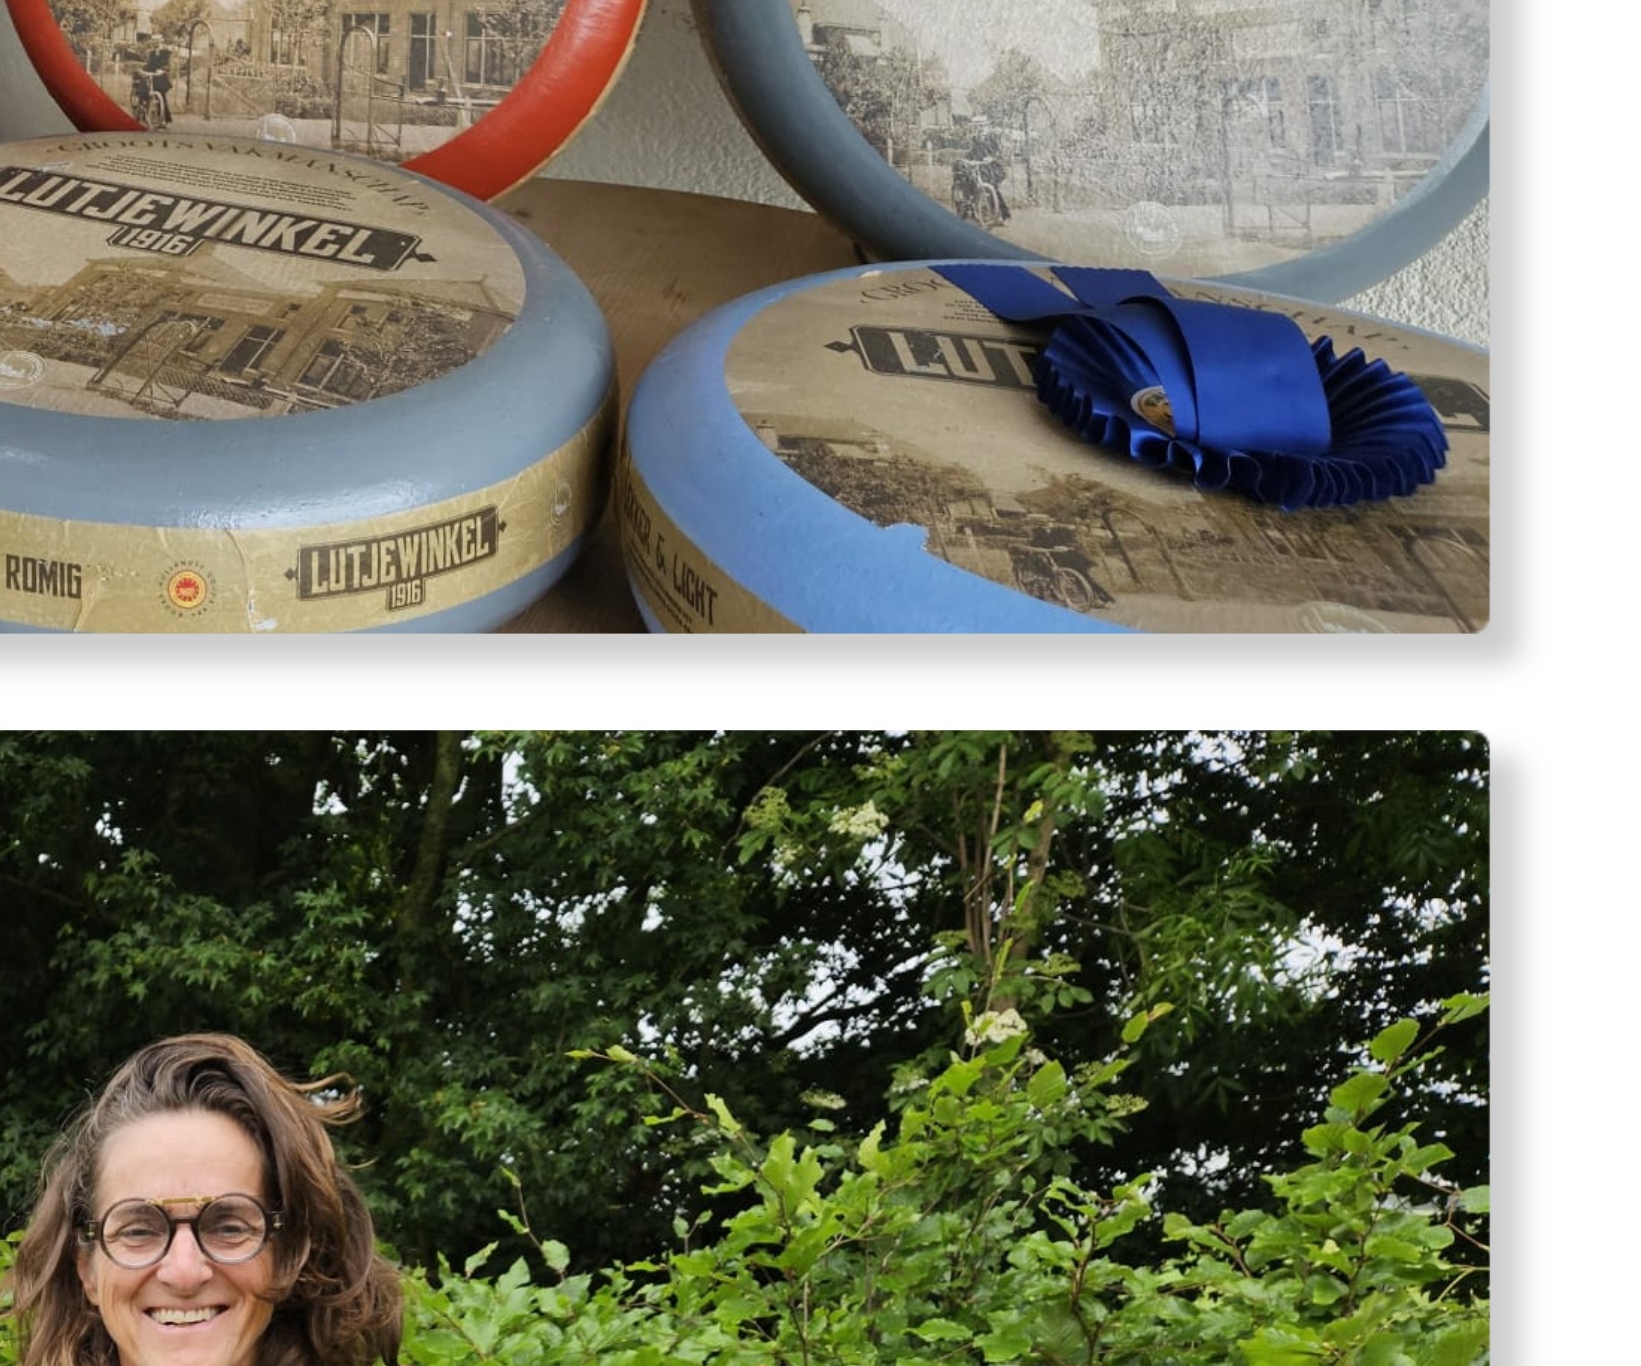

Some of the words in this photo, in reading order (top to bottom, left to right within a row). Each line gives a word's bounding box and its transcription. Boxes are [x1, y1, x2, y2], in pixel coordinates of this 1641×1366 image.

[121, 228, 193, 257] 1916
[6, 553, 82, 599] ROMIG
[310, 515, 490, 595] LUTJEWINKEL
[391, 579, 421, 609] 1916
[673, 553, 718, 626] LICHT
